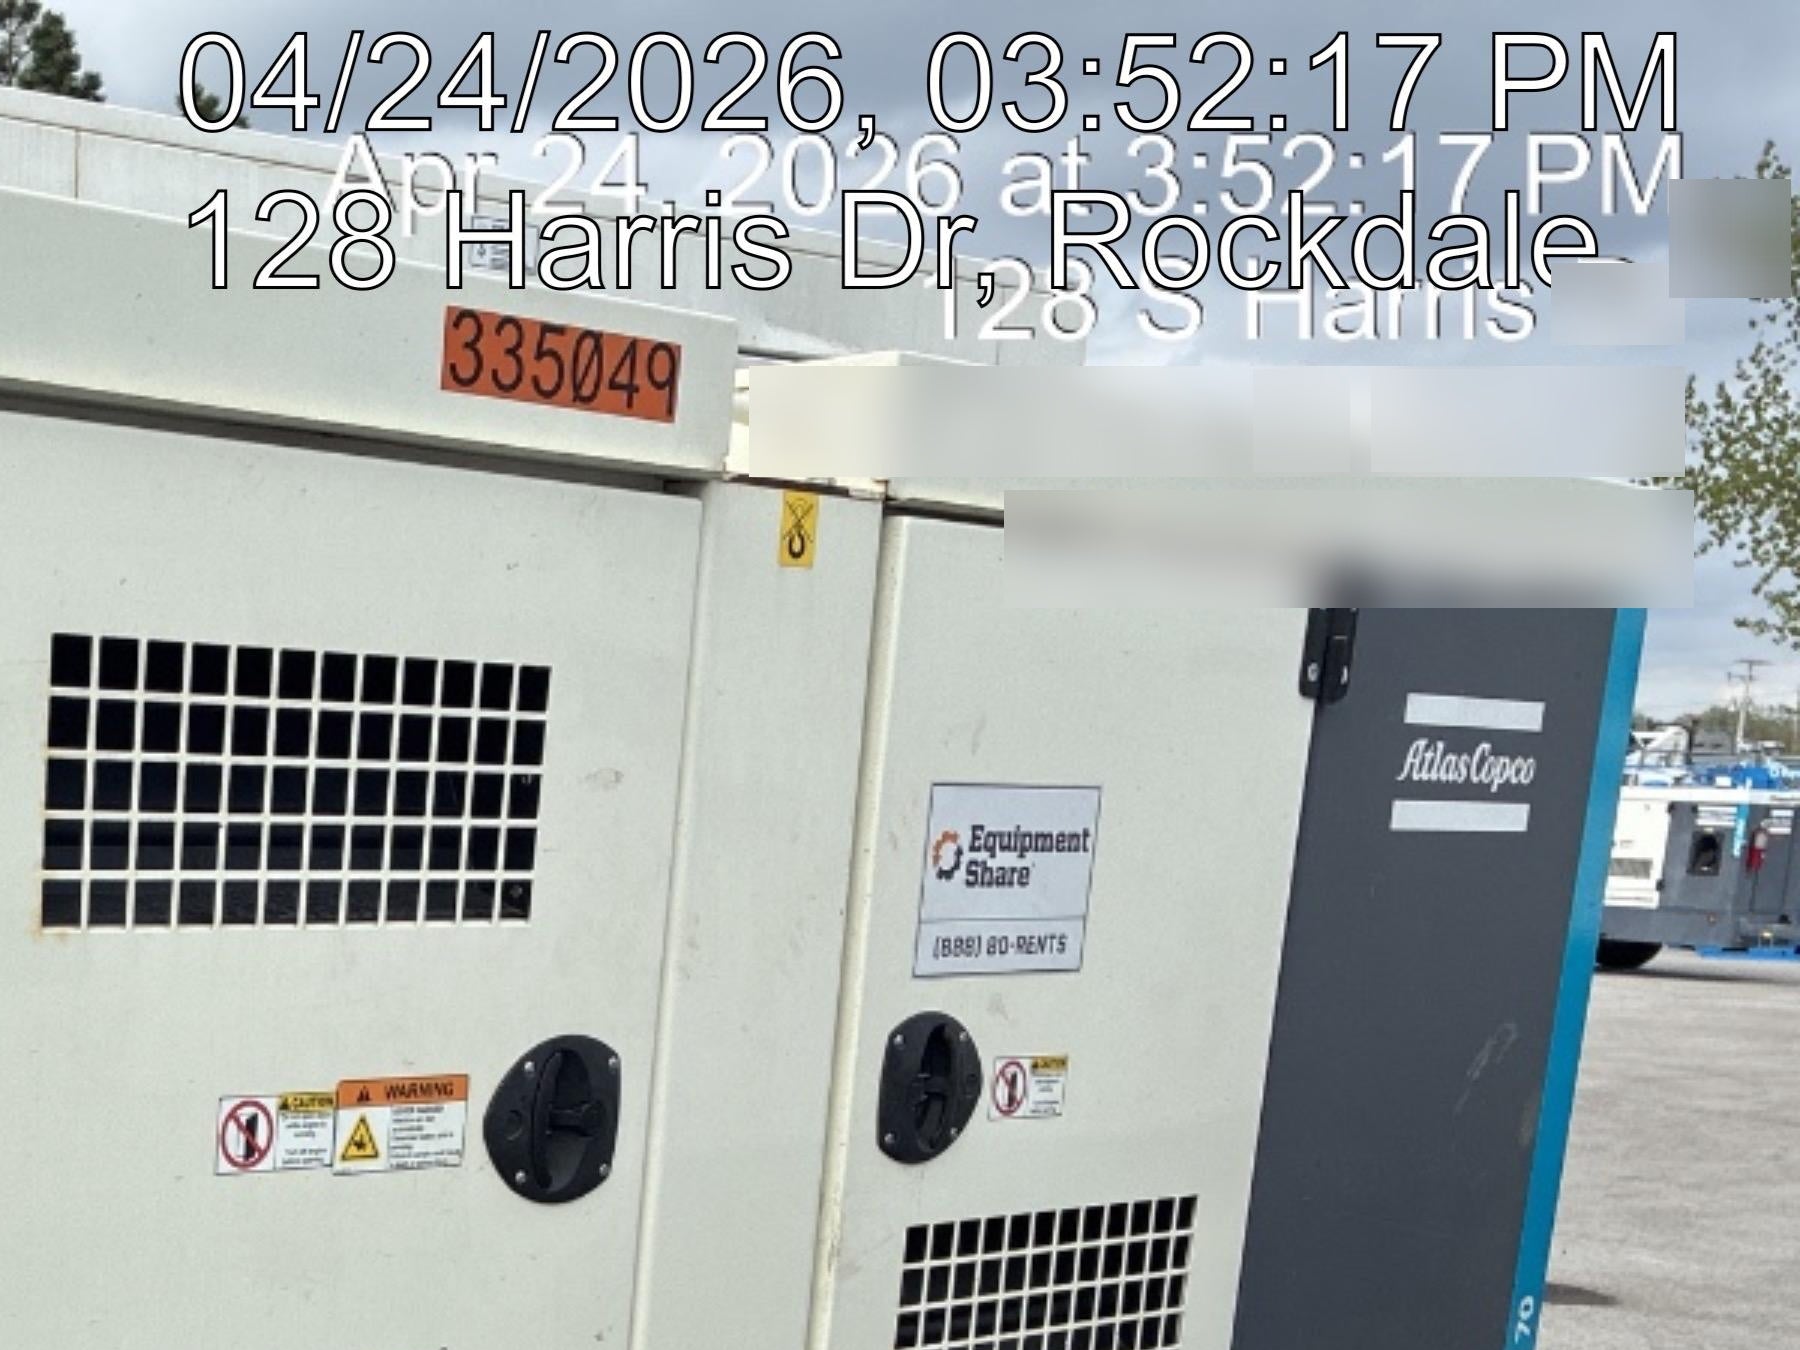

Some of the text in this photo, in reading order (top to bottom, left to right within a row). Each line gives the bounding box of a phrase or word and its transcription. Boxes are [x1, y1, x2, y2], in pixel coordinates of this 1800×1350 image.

[448, 308, 680, 417] 335049
[968, 824, 1090, 859] Equipment
[964, 861, 1031, 888] Share
[932, 933, 1068, 959] (888) 80-RENTS
[384, 1082, 455, 1100] WARNING
[1514, 1296, 1535, 1344] 70
